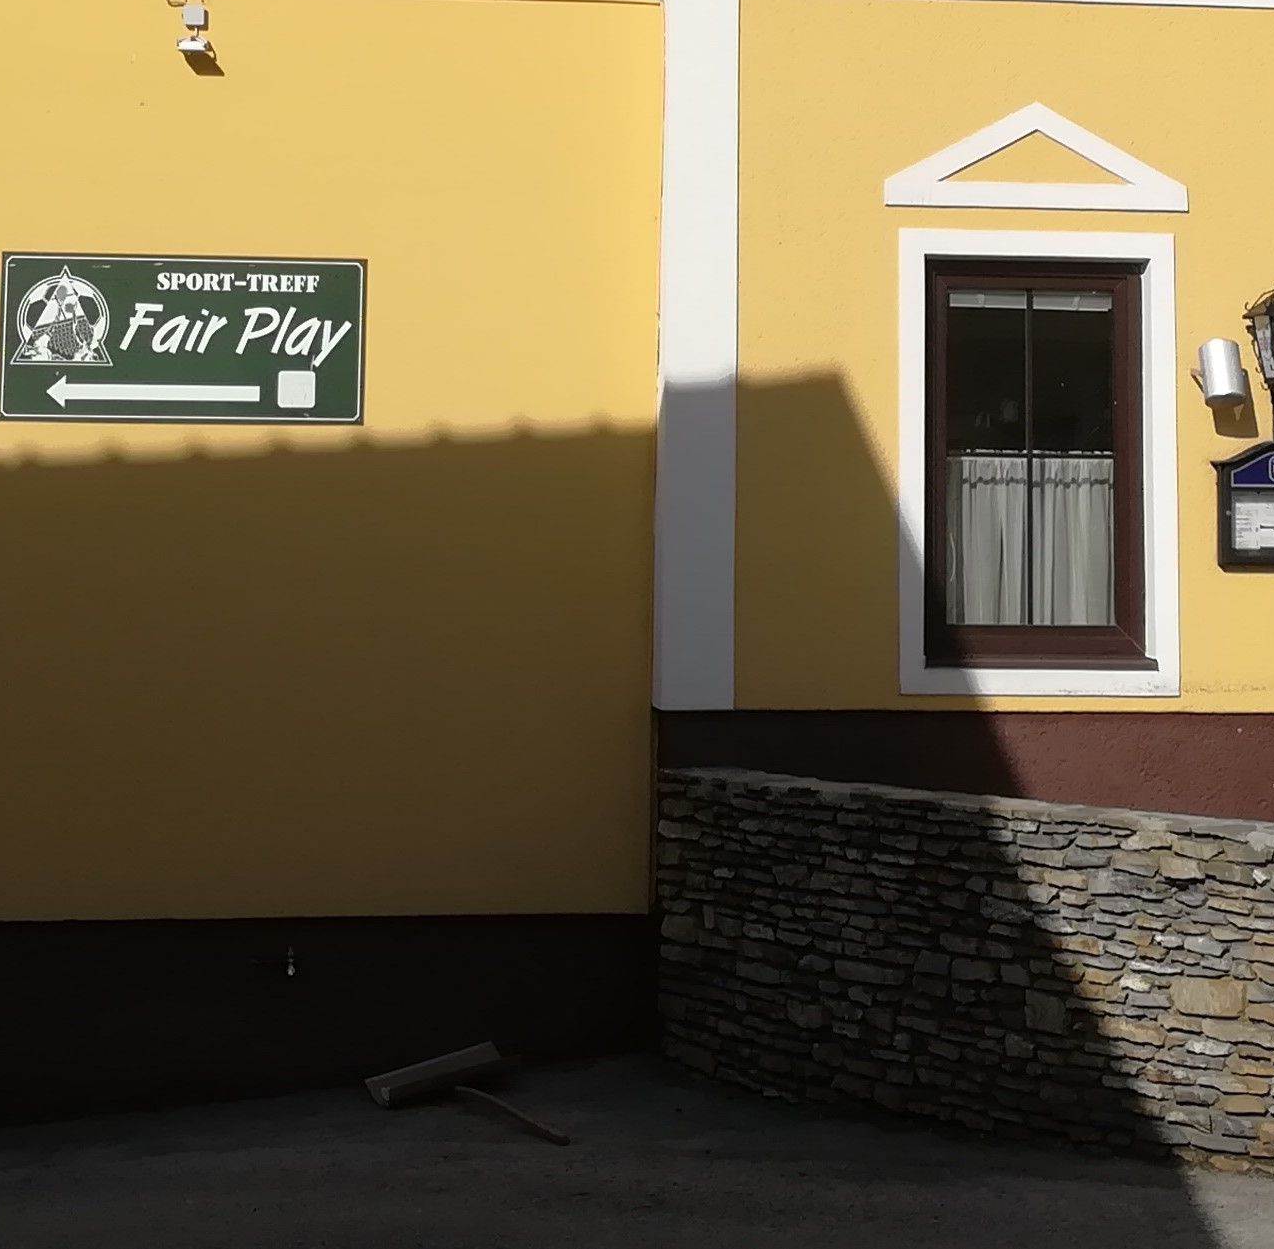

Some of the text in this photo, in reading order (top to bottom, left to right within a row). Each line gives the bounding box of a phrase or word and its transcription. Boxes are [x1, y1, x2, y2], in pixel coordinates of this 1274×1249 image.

[156, 272, 320, 293] SPORT-TREFF
[119, 302, 353, 368] Fair Play
